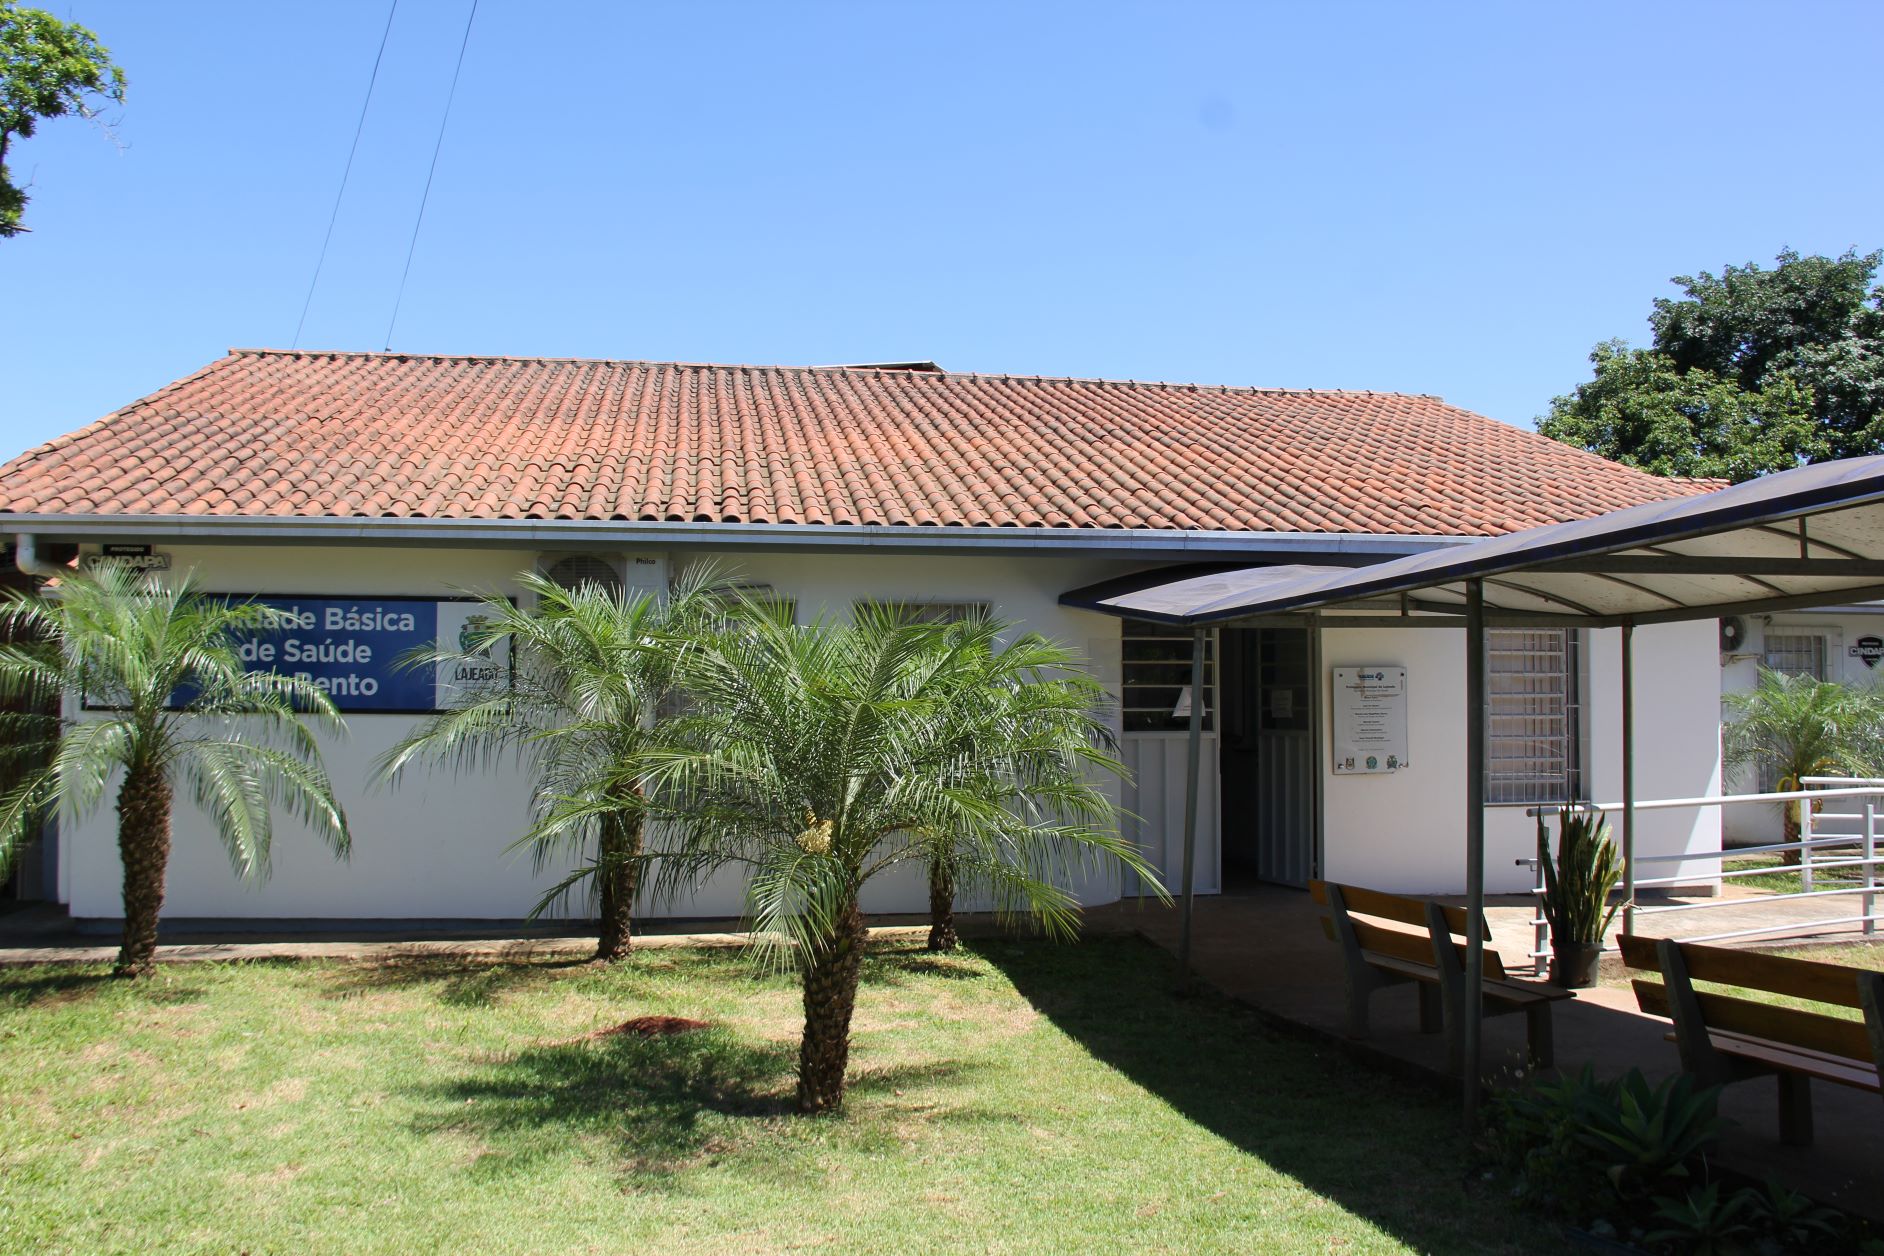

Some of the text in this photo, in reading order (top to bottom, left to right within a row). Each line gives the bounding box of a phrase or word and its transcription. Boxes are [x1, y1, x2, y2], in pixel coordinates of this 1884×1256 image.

[636, 557, 656, 565] Philco
[325, 606, 415, 631] Básica
[239, 638, 372, 663] de Saúde
[295, 672, 378, 695] Bento
